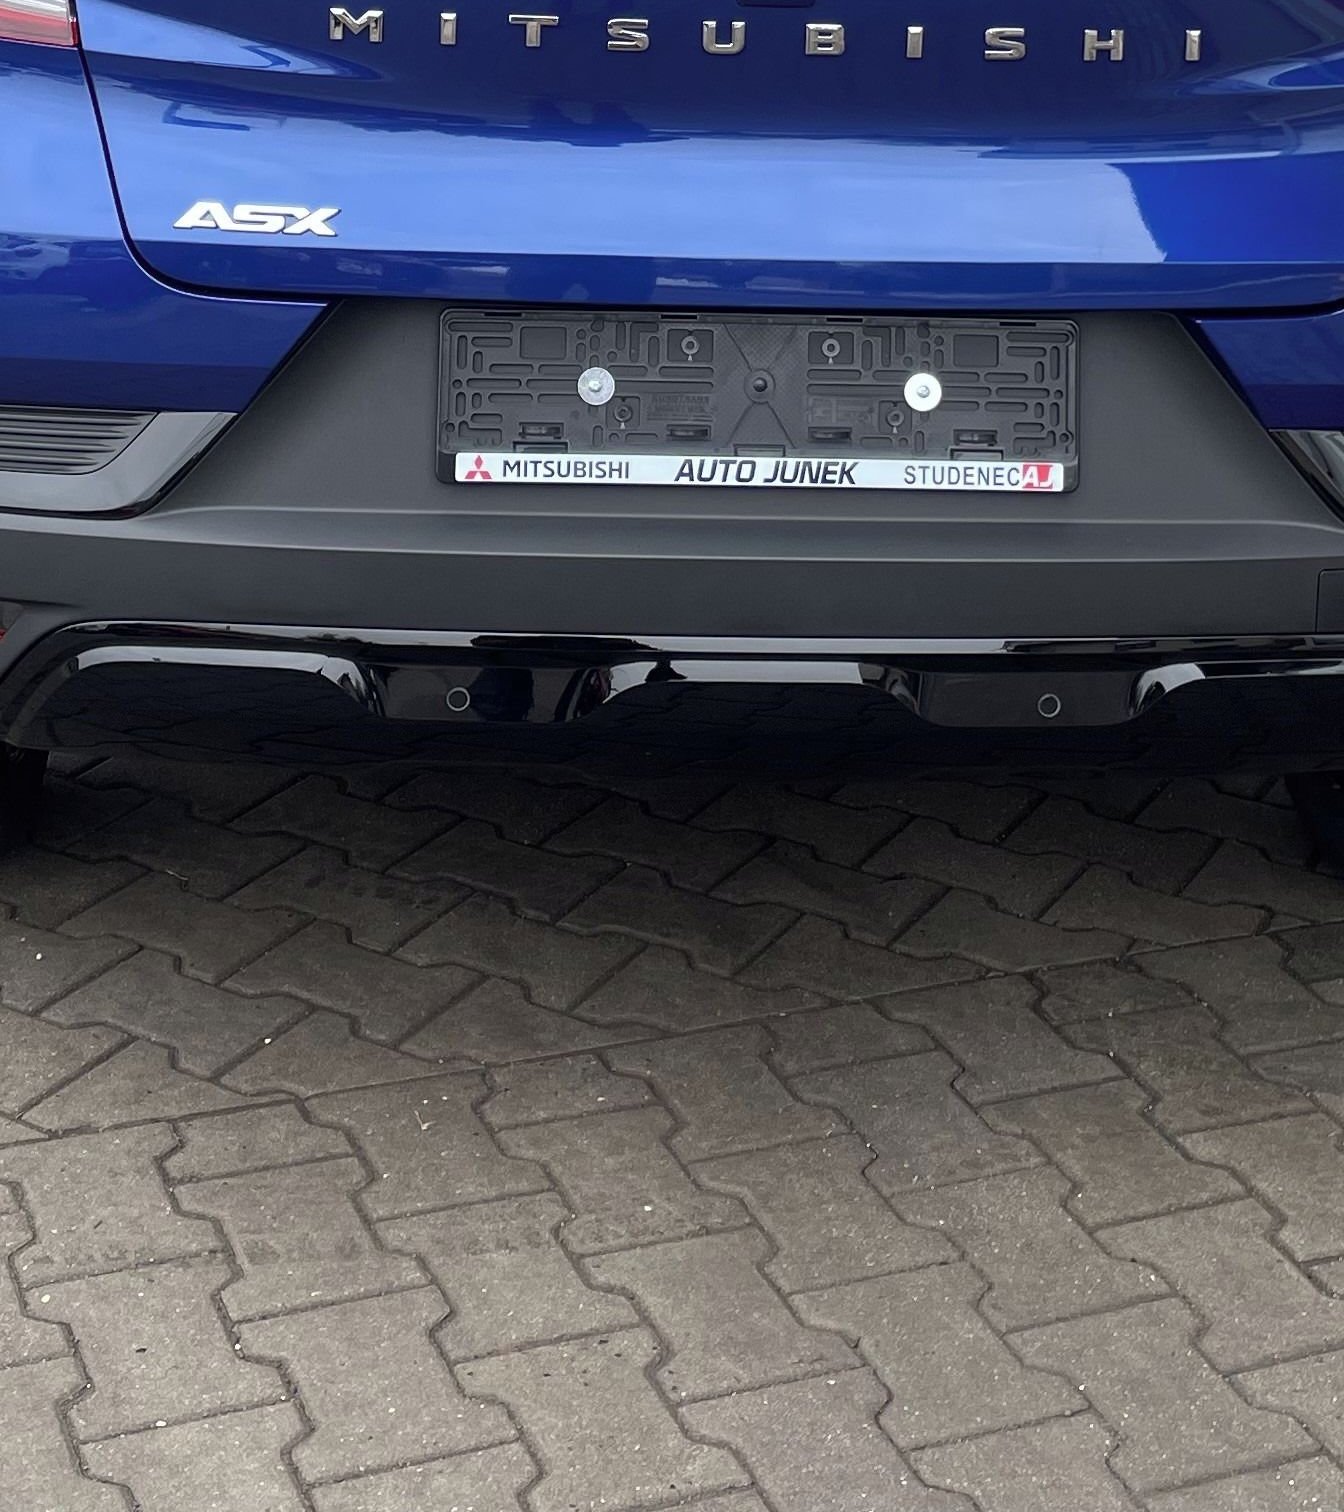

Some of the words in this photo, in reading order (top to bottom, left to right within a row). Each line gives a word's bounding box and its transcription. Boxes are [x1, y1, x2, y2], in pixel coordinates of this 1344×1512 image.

[328, 5, 1203, 63] MITSUBISHI
[173, 201, 342, 237] ASX
[502, 460, 630, 480] MITSUBISHI
[674, 458, 757, 483] AUTO
[763, 460, 859, 486] JUNEK
[903, 465, 1021, 487] STUDENEC
